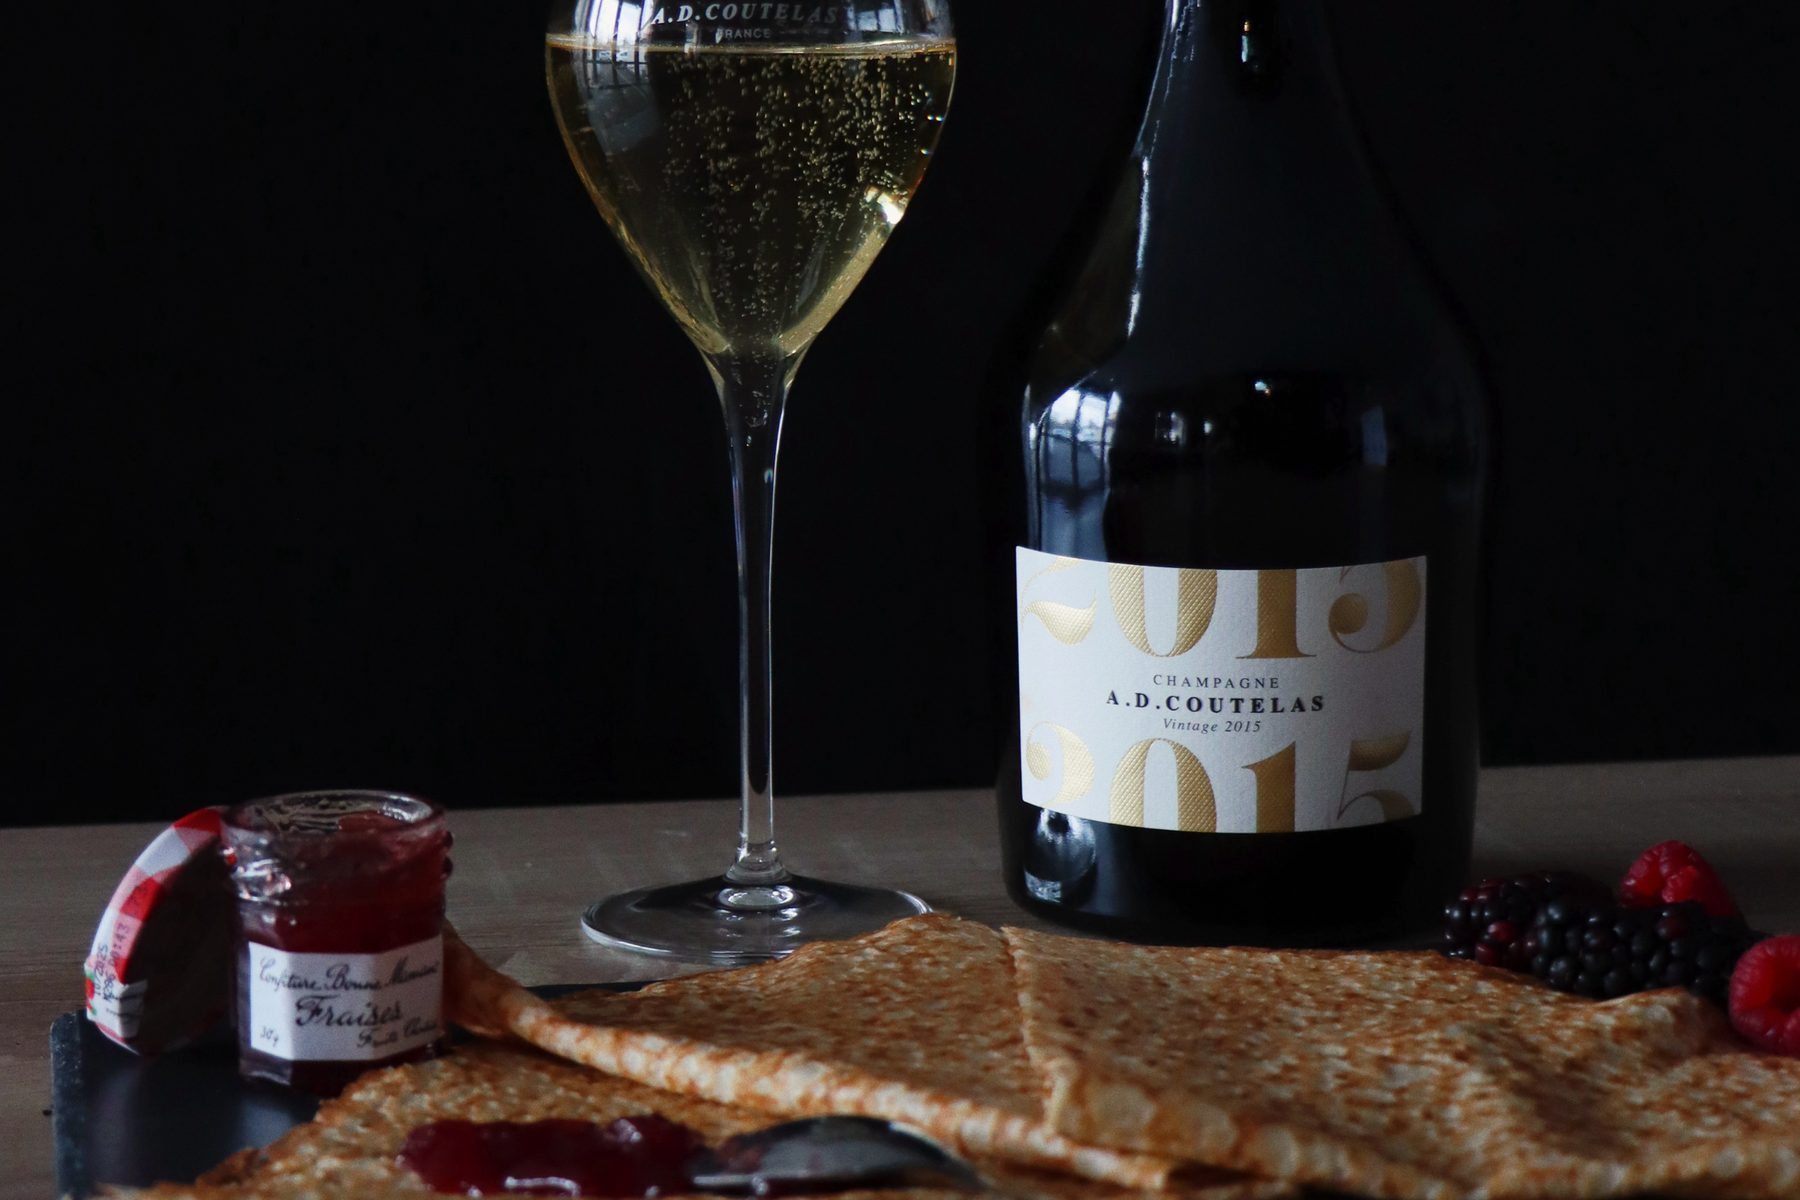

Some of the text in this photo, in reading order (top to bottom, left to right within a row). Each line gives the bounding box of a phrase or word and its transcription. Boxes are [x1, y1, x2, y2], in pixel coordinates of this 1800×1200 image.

[651, 2, 839, 25] A.D.COUTELAS
[1152, 674, 1281, 690] CHAMPAGNE
[1106, 690, 1326, 714] A.D.COUTELAS
[1162, 718, 1262, 734] Vintage 2015
[295, 994, 401, 1027] Fraises
